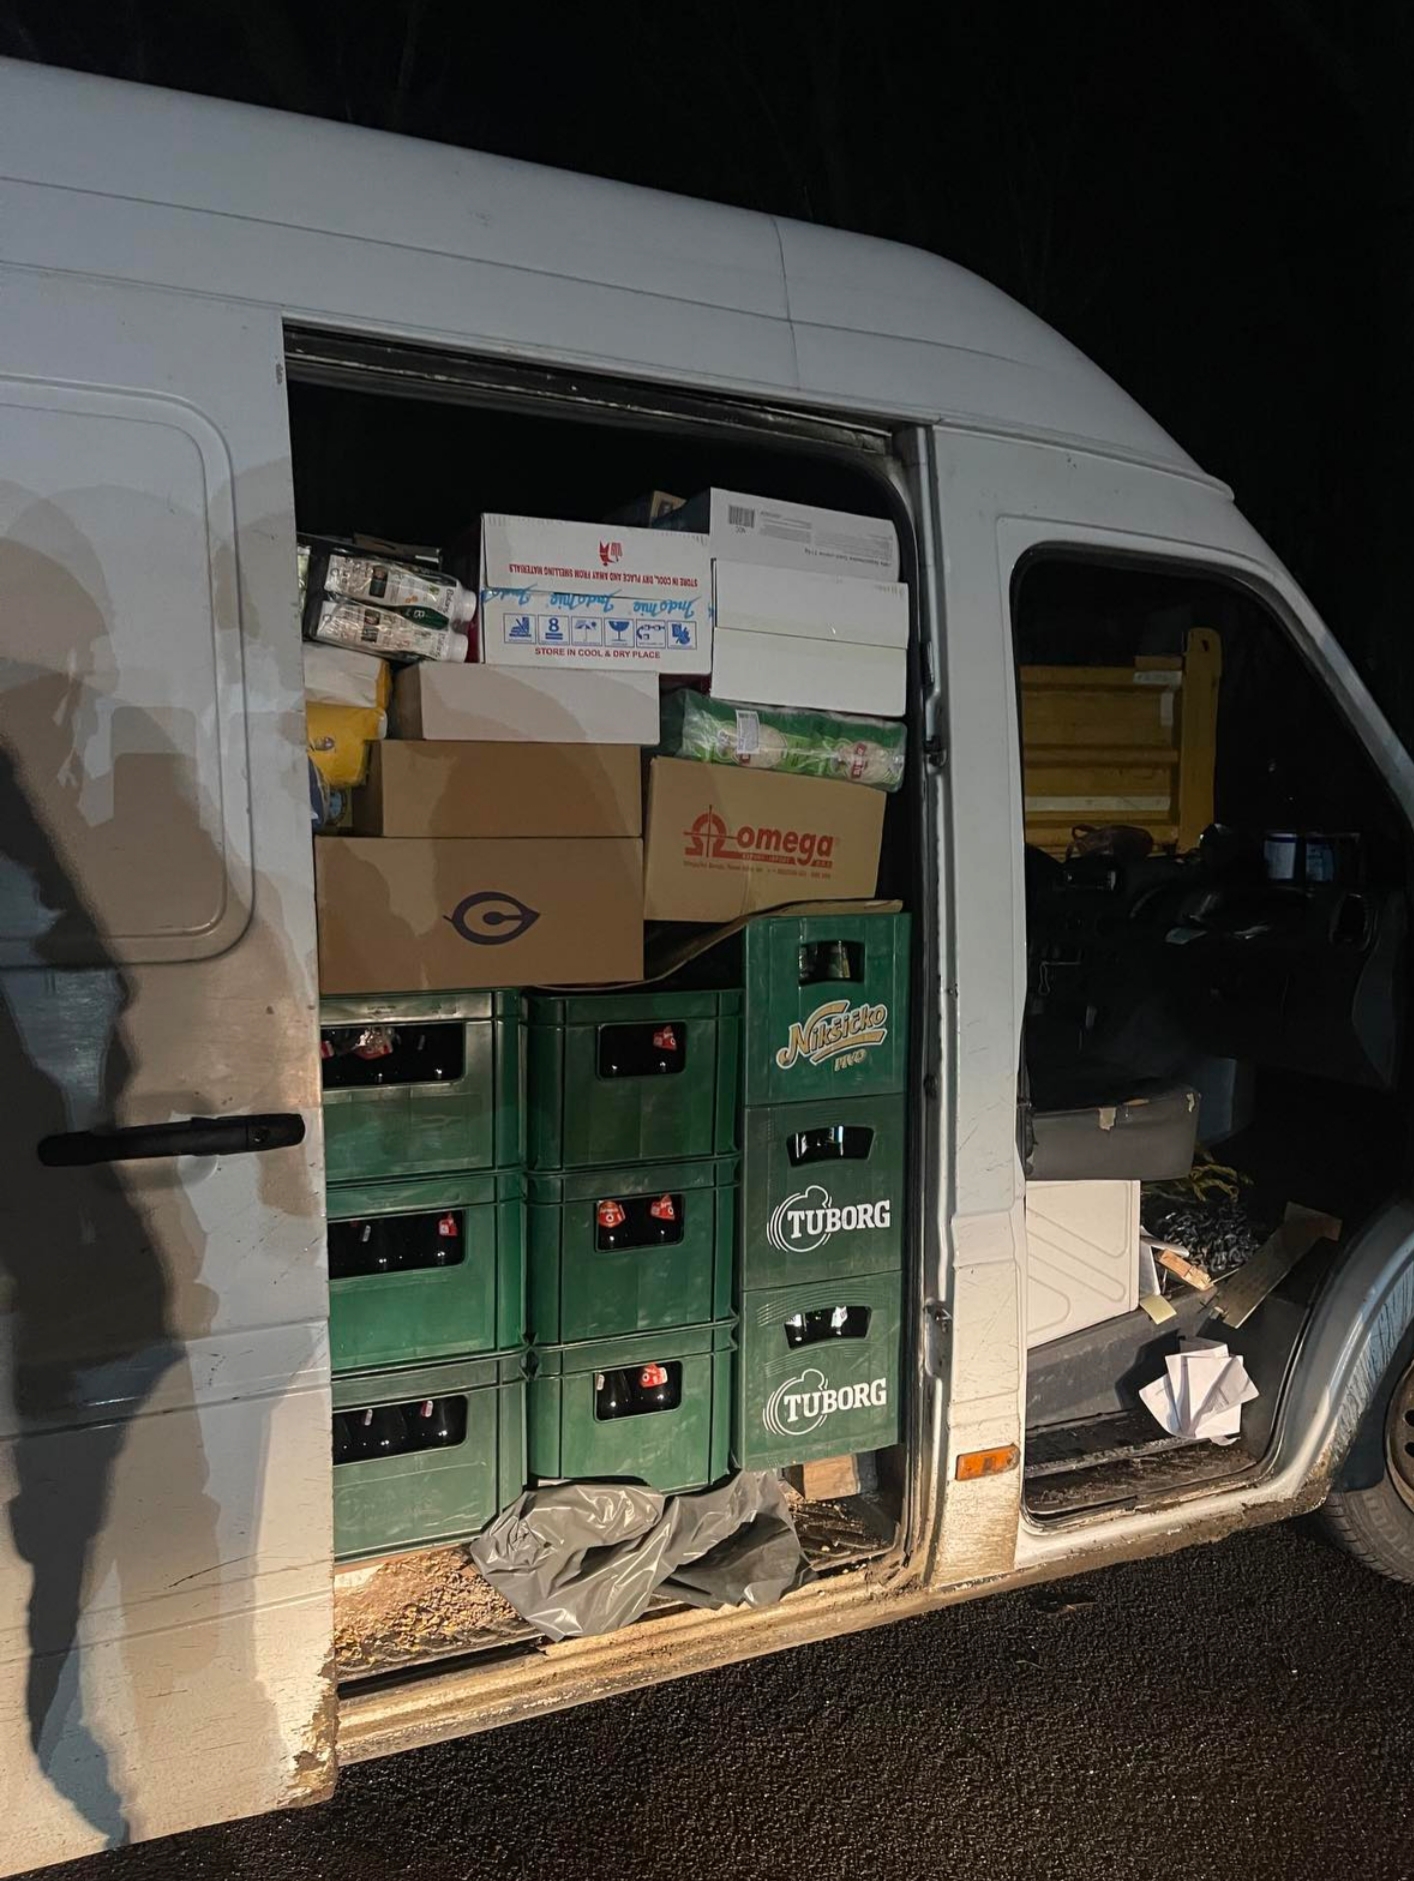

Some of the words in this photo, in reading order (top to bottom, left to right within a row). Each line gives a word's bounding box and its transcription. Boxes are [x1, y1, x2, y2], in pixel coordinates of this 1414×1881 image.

[509, 563, 543, 575] MATERIALS
[544, 566, 573, 579] SMELLING
[574, 569, 591, 580] FROM
[592, 570, 608, 581] AWAY
[610, 572, 622, 582] AND
[623, 573, 641, 583] PLACE
[642, 574, 654, 585] DRY
[671, 577, 679, 587] IN
[680, 577, 698, 588] STORE
[534, 647, 566, 657] STORE
[567, 648, 577, 657] IN
[578, 648, 603, 658] COOL
[604, 649, 612, 658] &
[613, 650, 631, 659] DRY
[632, 650, 661, 660] PLACE
[737, 826, 834, 867] omega
[787, 1200, 891, 1239] TUBORG
[783, 1378, 887, 1423] TUBORG
